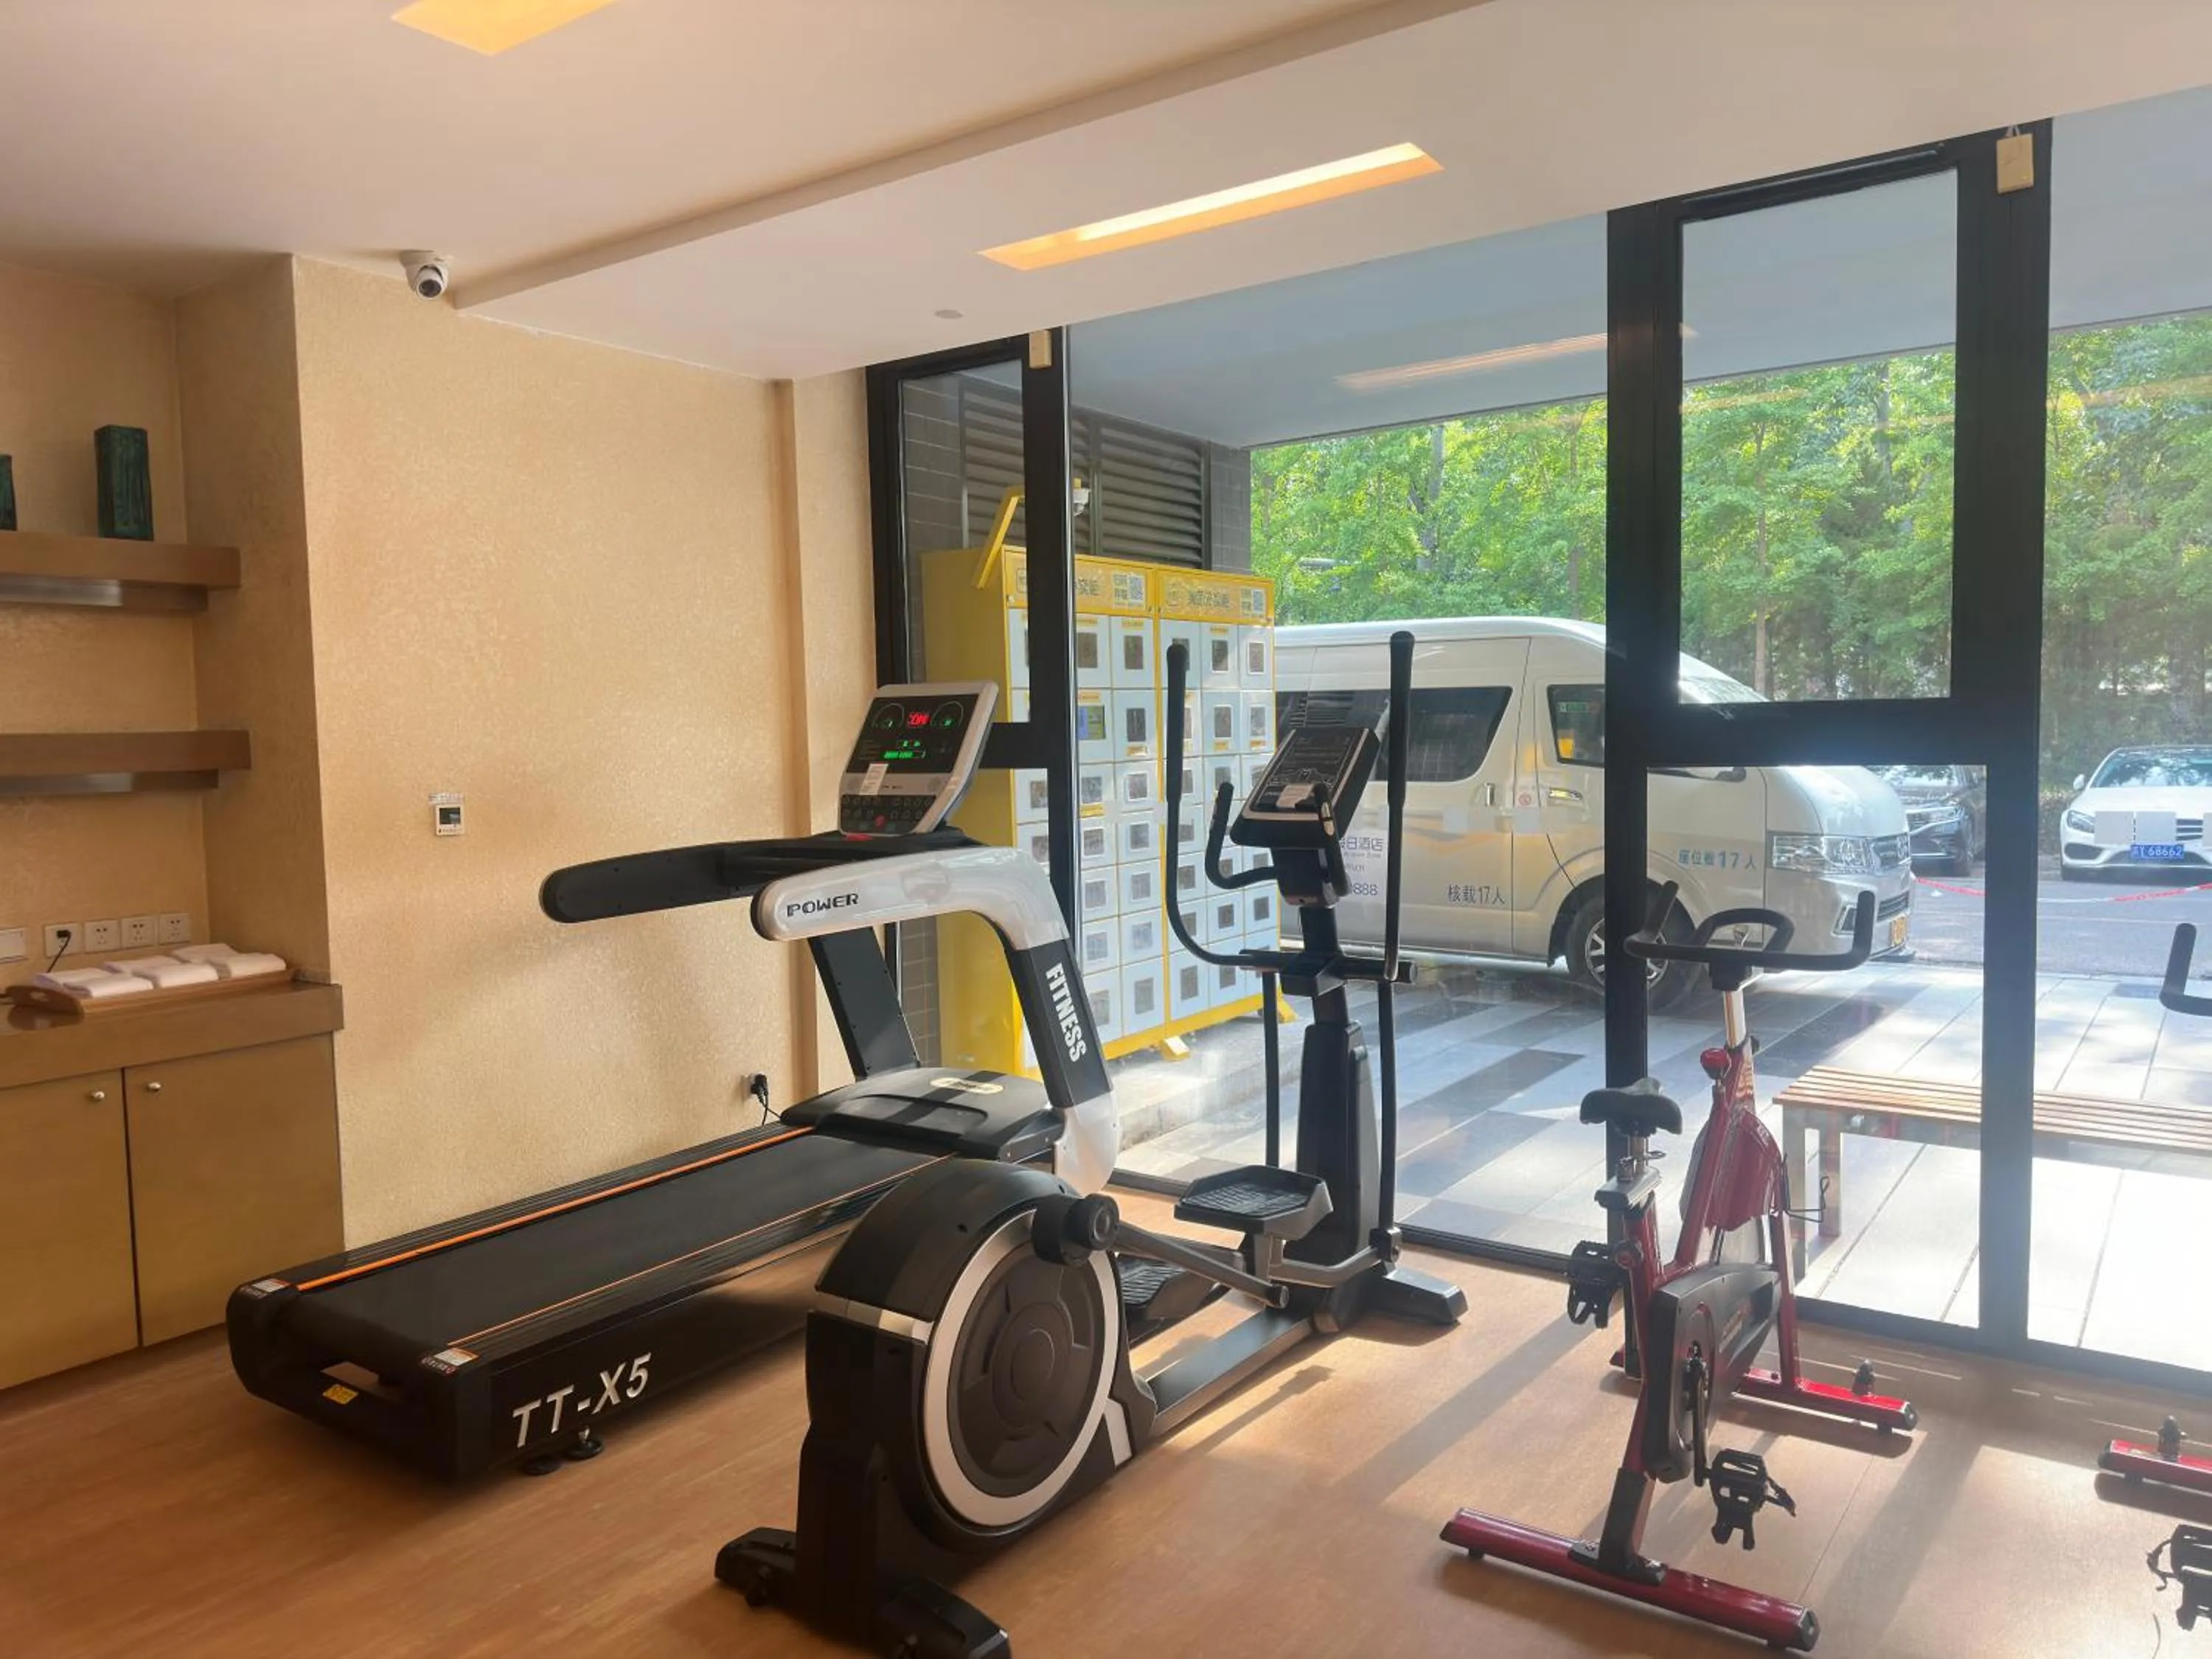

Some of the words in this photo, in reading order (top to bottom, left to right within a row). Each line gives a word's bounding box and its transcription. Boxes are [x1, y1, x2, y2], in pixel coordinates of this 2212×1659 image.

[1351, 883, 1379, 896] 888
[1447, 885, 1506, 905] 核载17人
[786, 893, 859, 917] POWER
[1046, 962, 1087, 1062] FITNESS
[512, 1352, 652, 1449] TT-X5
